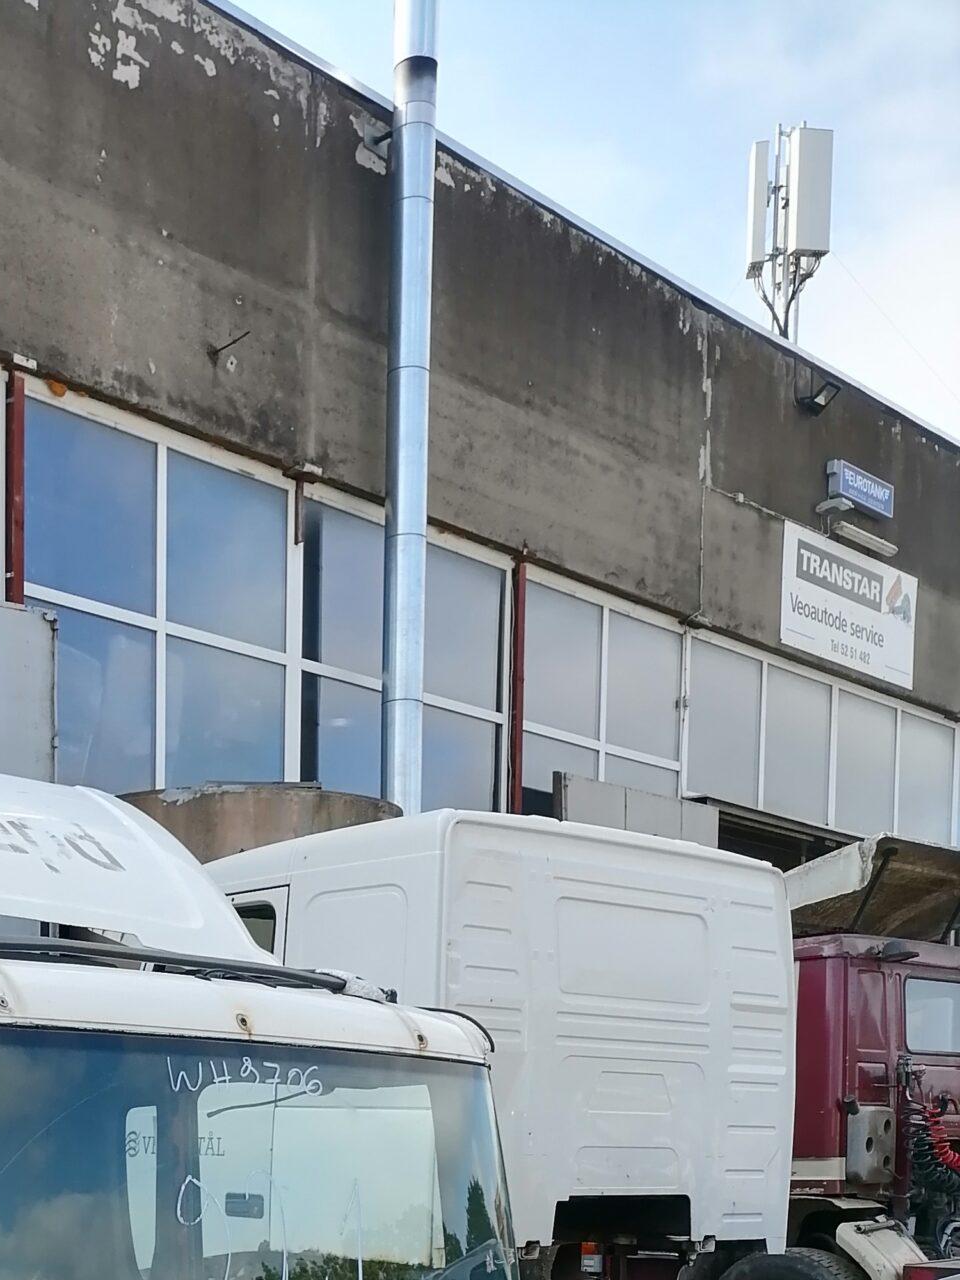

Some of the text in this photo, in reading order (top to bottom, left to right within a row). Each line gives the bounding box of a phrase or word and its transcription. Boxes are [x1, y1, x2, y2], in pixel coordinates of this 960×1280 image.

[800, 548, 882, 603] TRANSTAR
[790, 592, 885, 648] Veoautode service
[830, 639, 840, 653] Tel
[840, 643, 849, 656] 52
[850, 646, 858, 660] 51
